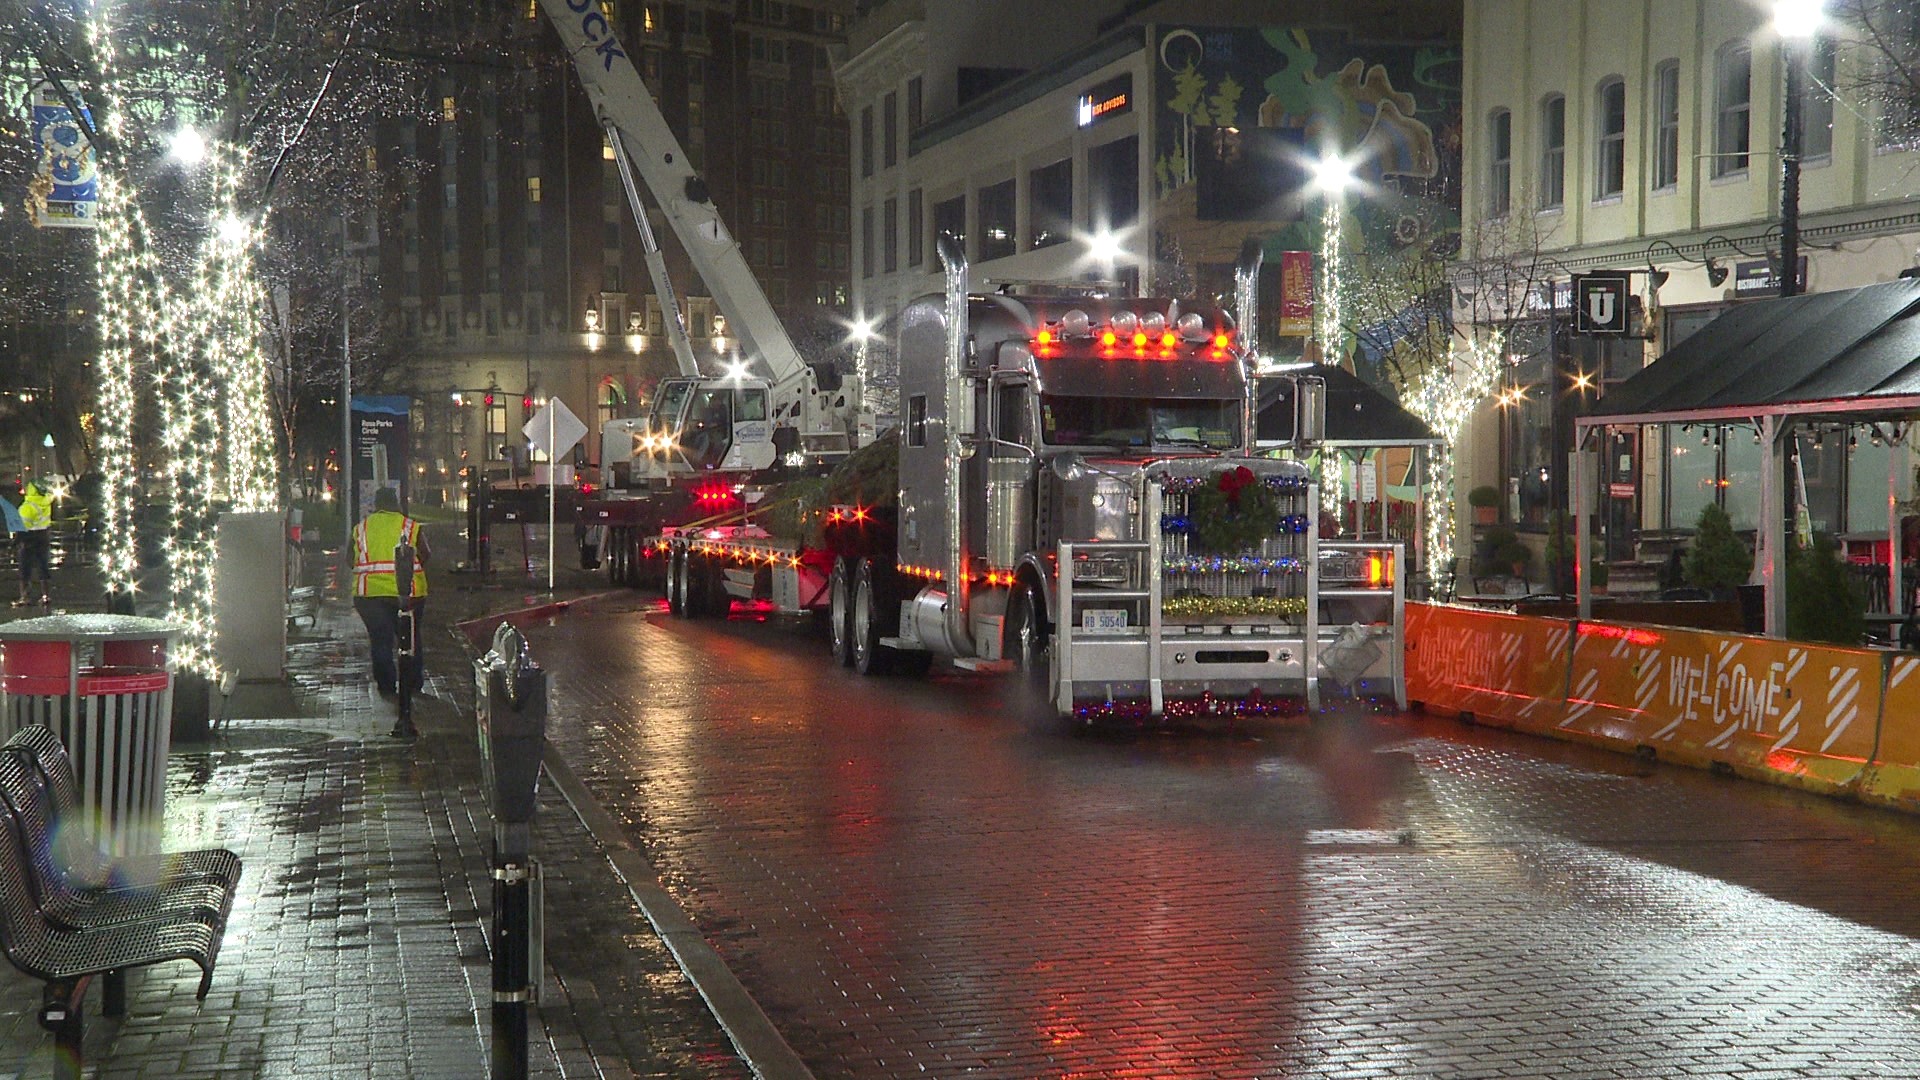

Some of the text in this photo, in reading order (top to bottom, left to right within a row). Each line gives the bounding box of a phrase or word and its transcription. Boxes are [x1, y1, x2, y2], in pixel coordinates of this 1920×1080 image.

[1103, 94, 1126, 112] ADVISORS
[1589, 292, 1616, 325] U
[361, 419, 393, 427] Rosa Parks
[361, 427, 379, 435] Circle
[1669, 653, 1785, 732] WELCOME
